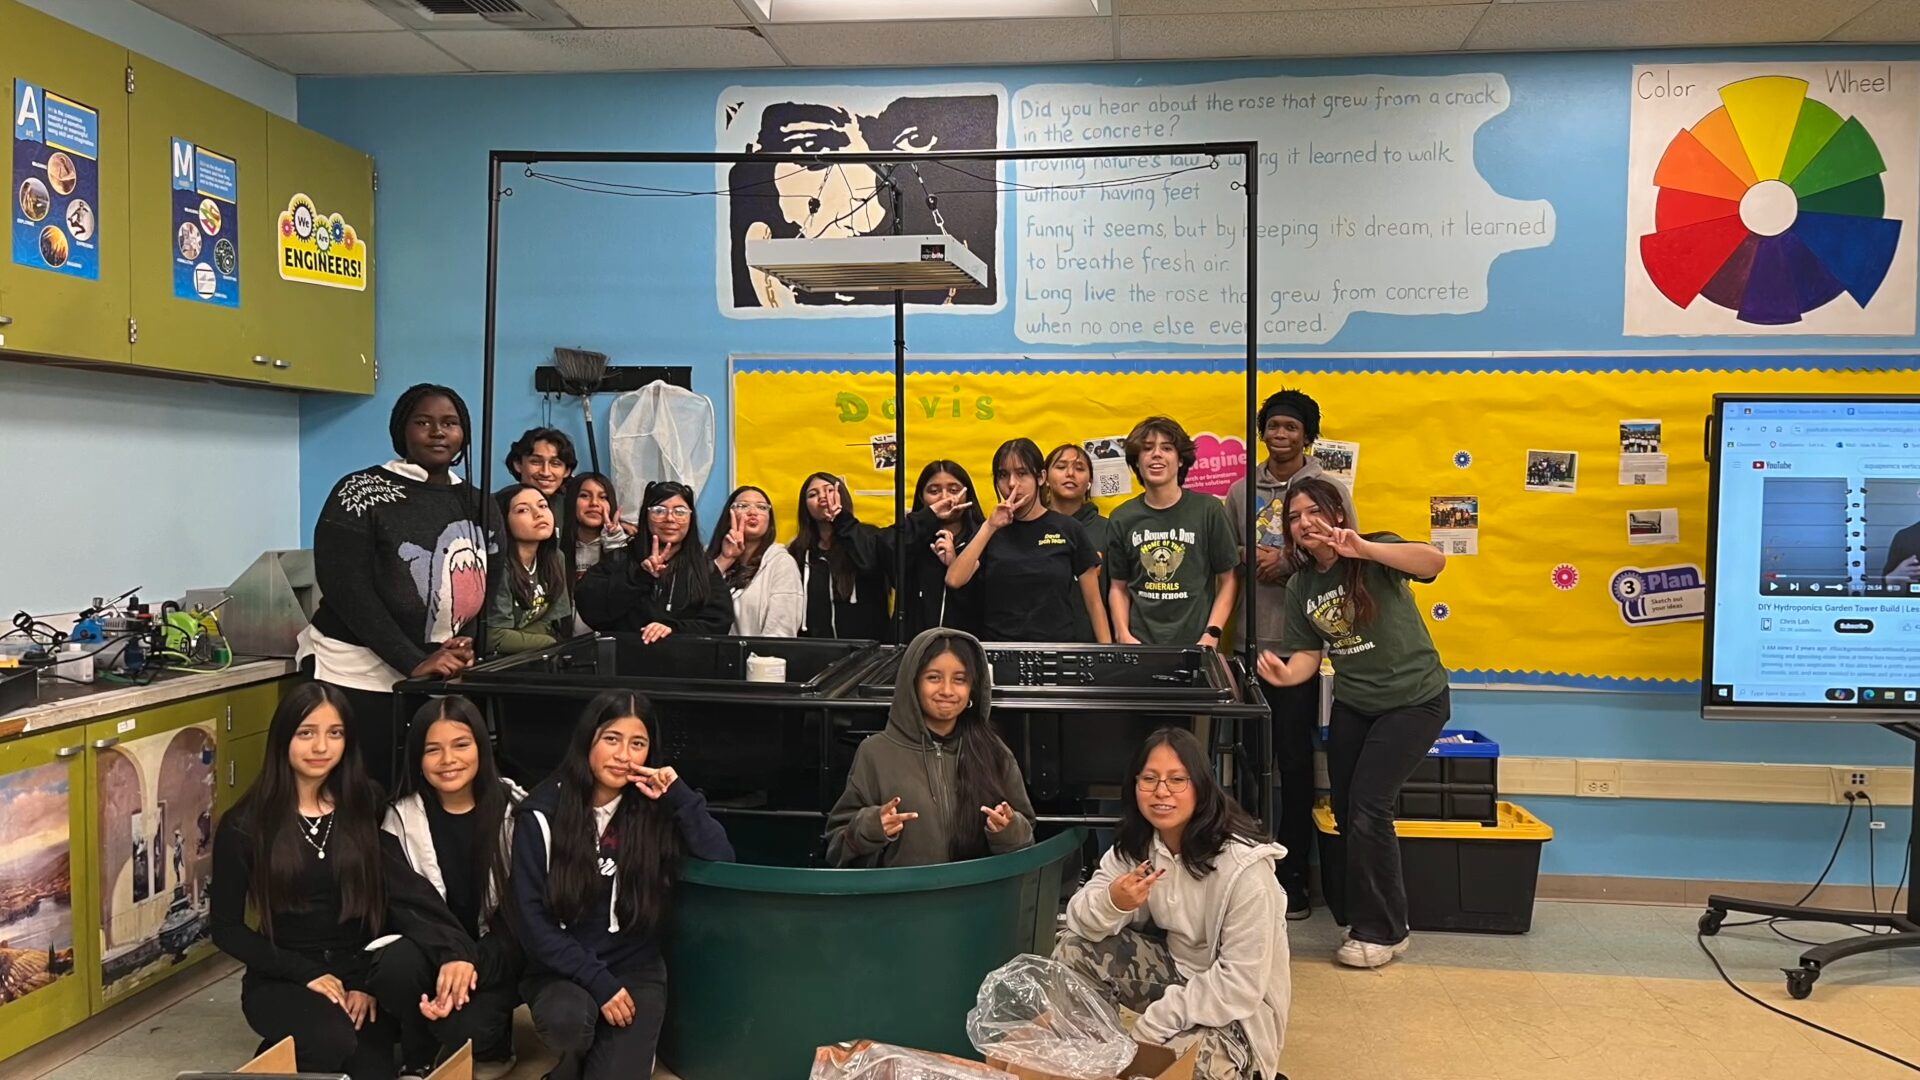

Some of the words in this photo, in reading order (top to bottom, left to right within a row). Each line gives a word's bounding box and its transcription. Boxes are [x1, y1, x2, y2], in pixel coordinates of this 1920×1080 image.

[1637, 71, 1696, 99] Color
[1825, 66, 1892, 94] Wheel
[17, 86, 41, 132] A
[1020, 99, 1051, 119] Did
[1061, 103, 1092, 127] you
[1099, 95, 1139, 116] hear
[1148, 92, 1198, 113] about
[1206, 91, 1234, 112] the
[1238, 95, 1276, 109] rose
[1282, 91, 1316, 109] that
[1321, 95, 1368, 118] grew
[1375, 86, 1421, 111] from
[1429, 91, 1440, 104] a
[1445, 82, 1499, 105] crack
[1023, 126, 1037, 143] in
[1044, 124, 1074, 143] the
[1082, 113, 1181, 140] concrete?
[173, 142, 194, 182] M
[1170, 154, 1200, 167] law
[1287, 147, 1301, 165] it
[1309, 140, 1378, 165] learned
[1383, 145, 1402, 164] to
[1409, 140, 1454, 164] walk
[1024, 181, 1086, 203] without
[1100, 184, 1156, 211] having
[1163, 177, 1201, 207] feet
[297, 215, 310, 228] We
[1083, 215, 1095, 237] it
[1103, 221, 1168, 240] seems,
[1174, 215, 1208, 237] but
[1216, 214, 1236, 249] by
[1330, 215, 1356, 238] it's
[1365, 214, 1434, 240] dream,
[1440, 218, 1456, 238] it
[1465, 210, 1547, 236] learned
[318, 233, 328, 243] Are
[284, 247, 362, 279] ENGINEERS!
[1026, 252, 1046, 271] to
[1056, 243, 1135, 271] breathe
[1141, 246, 1196, 274] fresh
[1025, 277, 1073, 315] Long
[1084, 279, 1117, 303] live
[1128, 282, 1156, 303] the
[1166, 286, 1209, 303] rose
[1220, 283, 1247, 304] tha
[1270, 288, 1320, 315] grew
[1332, 279, 1376, 304] from
[1386, 280, 1470, 301] concrete
[1026, 311, 1072, 334] when
[1081, 319, 1102, 335] no
[1110, 319, 1144, 334] one
[1153, 314, 1196, 334] else
[1263, 313, 1328, 334] cared.
[1188, 451, 1247, 473] agine
[1766, 461, 1792, 470] YouTube
[1144, 581, 1180, 591] GENERALS
[1623, 580, 1636, 595] 3
[1647, 572, 1694, 591] Plan
[1161, 591, 1189, 600] SCHOOL
[1650, 597, 1672, 605] Sketch
[1652, 605, 1666, 613] your
[1758, 603, 1771, 611] DIY
[1774, 604, 1823, 613] Hydroponics
[1825, 604, 1853, 612] Garden
[1855, 604, 1878, 613] Tower
[1880, 604, 1900, 613] Build
